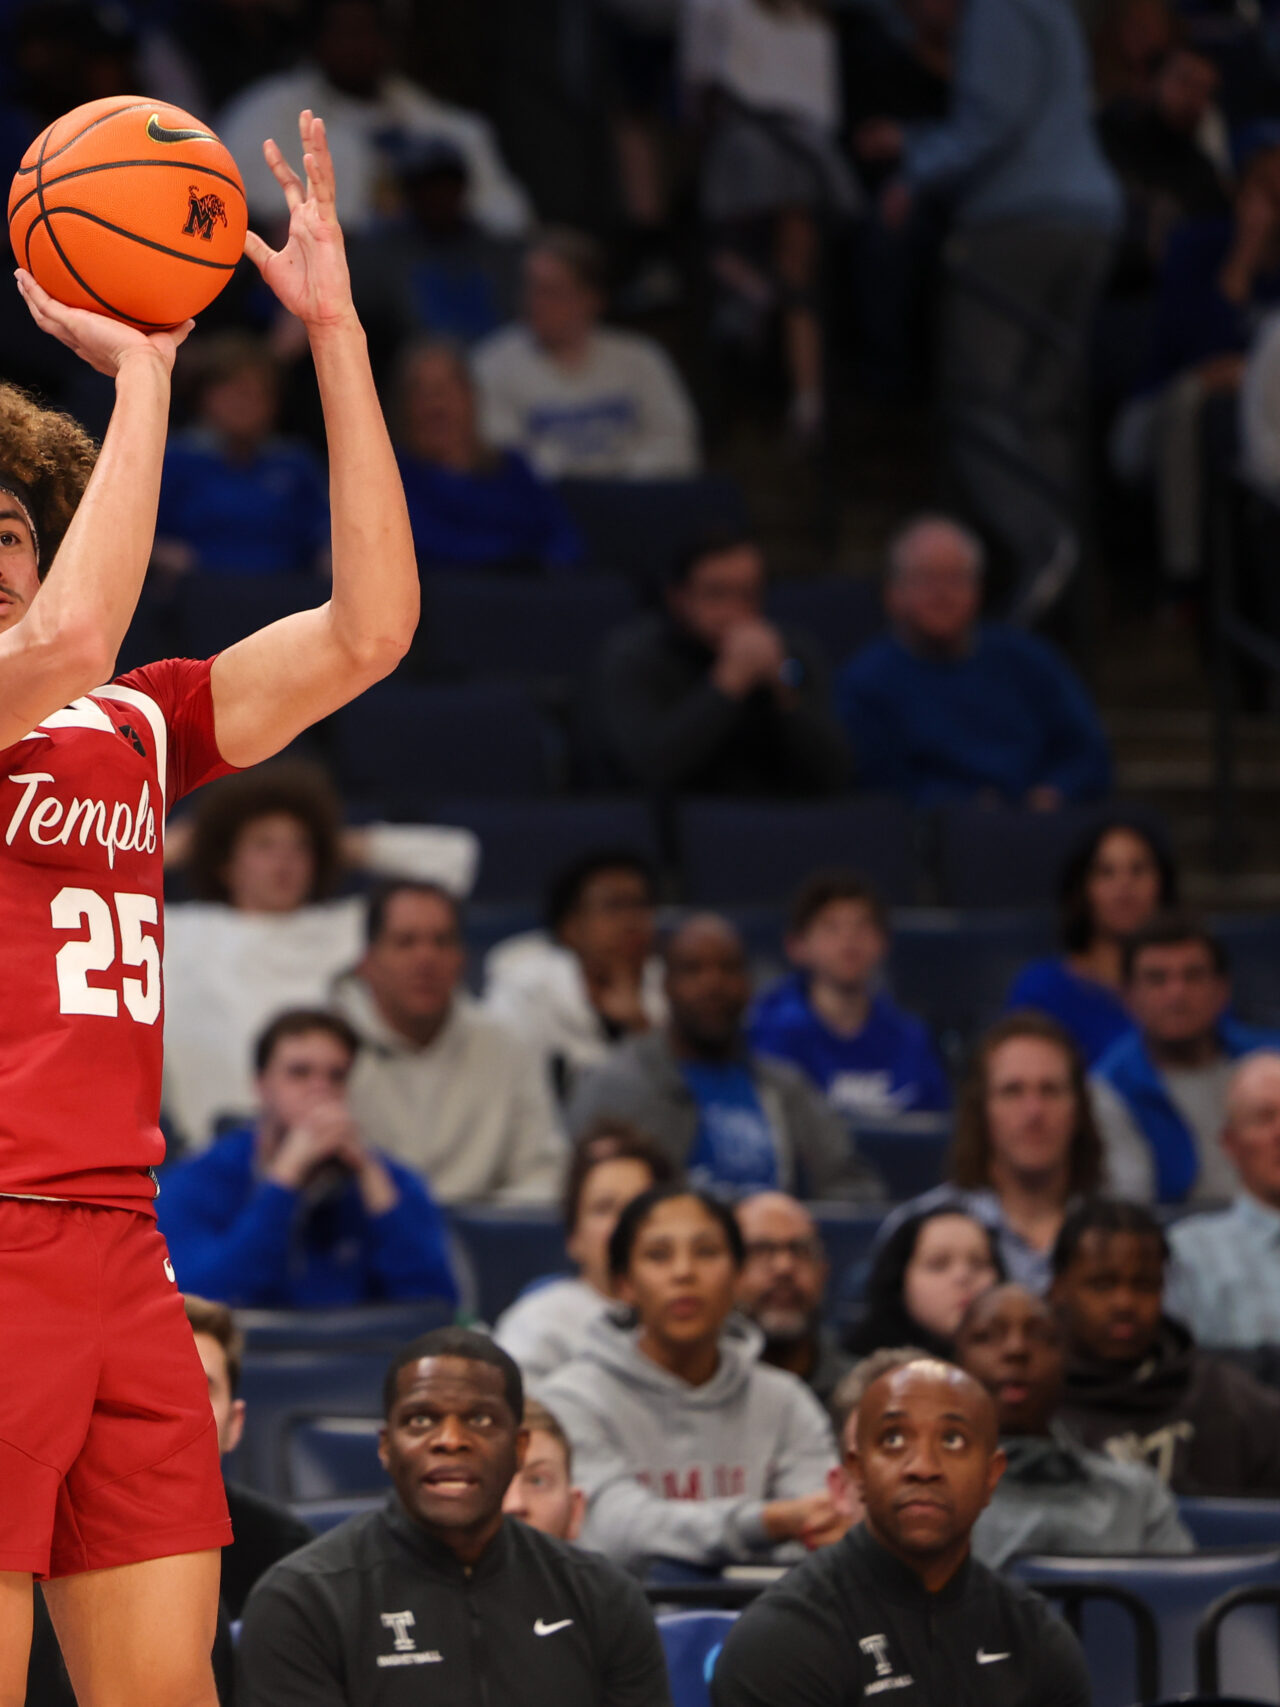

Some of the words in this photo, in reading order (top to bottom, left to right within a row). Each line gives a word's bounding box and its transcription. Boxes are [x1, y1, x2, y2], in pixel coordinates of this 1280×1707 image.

[5, 772, 157, 870] Temple
[50, 887, 161, 1025] 25
[380, 1609, 417, 1651] T
[858, 1633, 893, 1676] T
